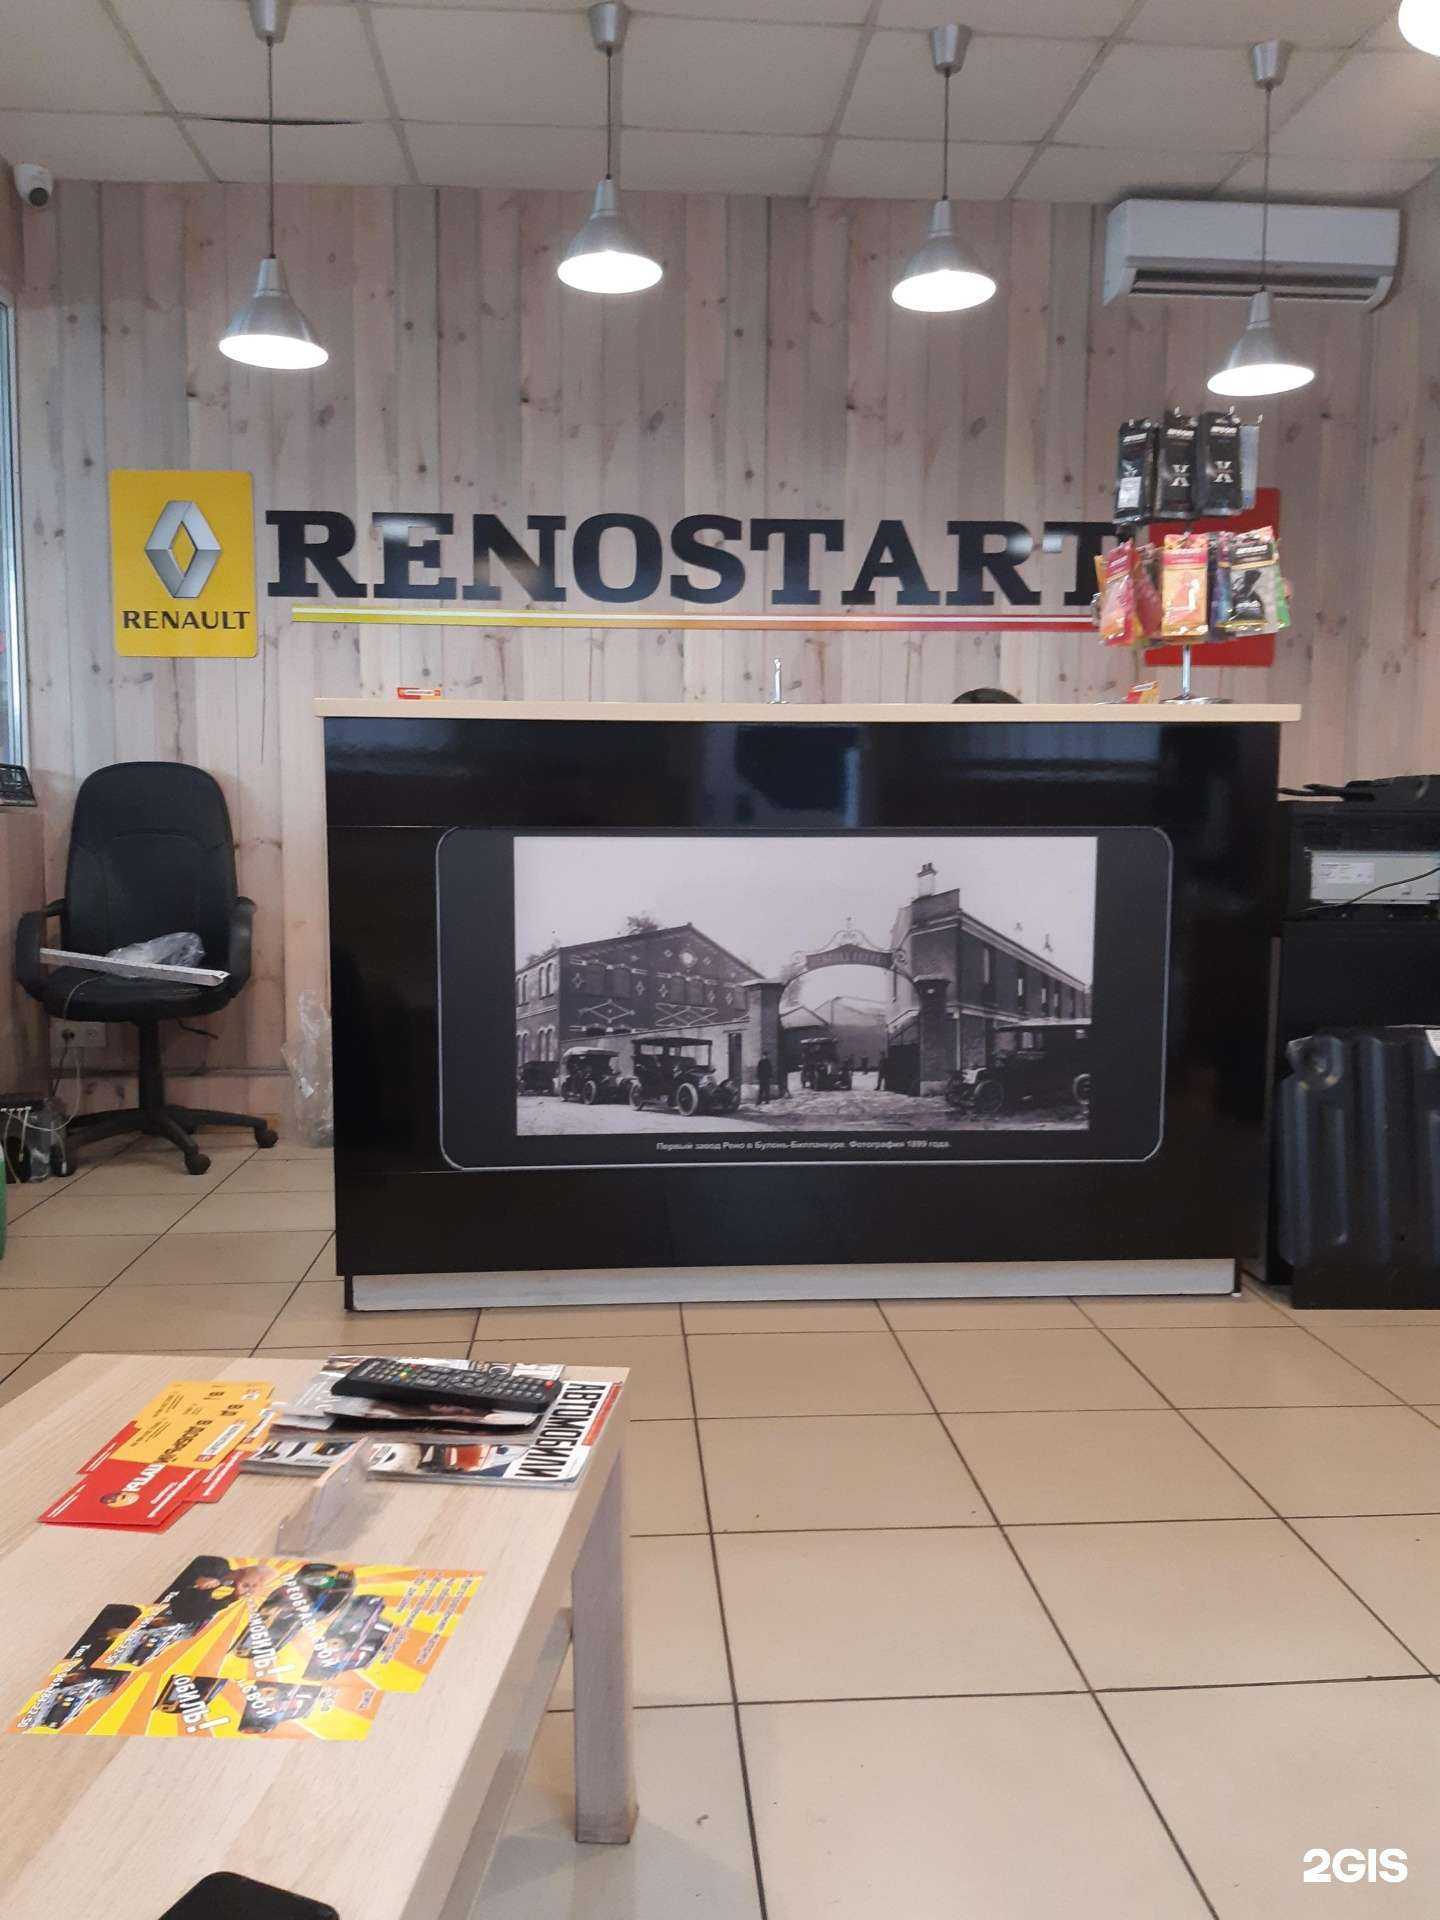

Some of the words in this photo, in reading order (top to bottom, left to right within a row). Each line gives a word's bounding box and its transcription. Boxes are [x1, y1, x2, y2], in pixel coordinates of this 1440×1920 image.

[265, 509, 1119, 608] RENOSTART
[122, 609, 250, 631] RENAULT
[656, 1142, 693, 1151] Первый
[723, 1141, 745, 1150] Рено
[514, 1383, 606, 1478] АВТОМОБИЛИ
